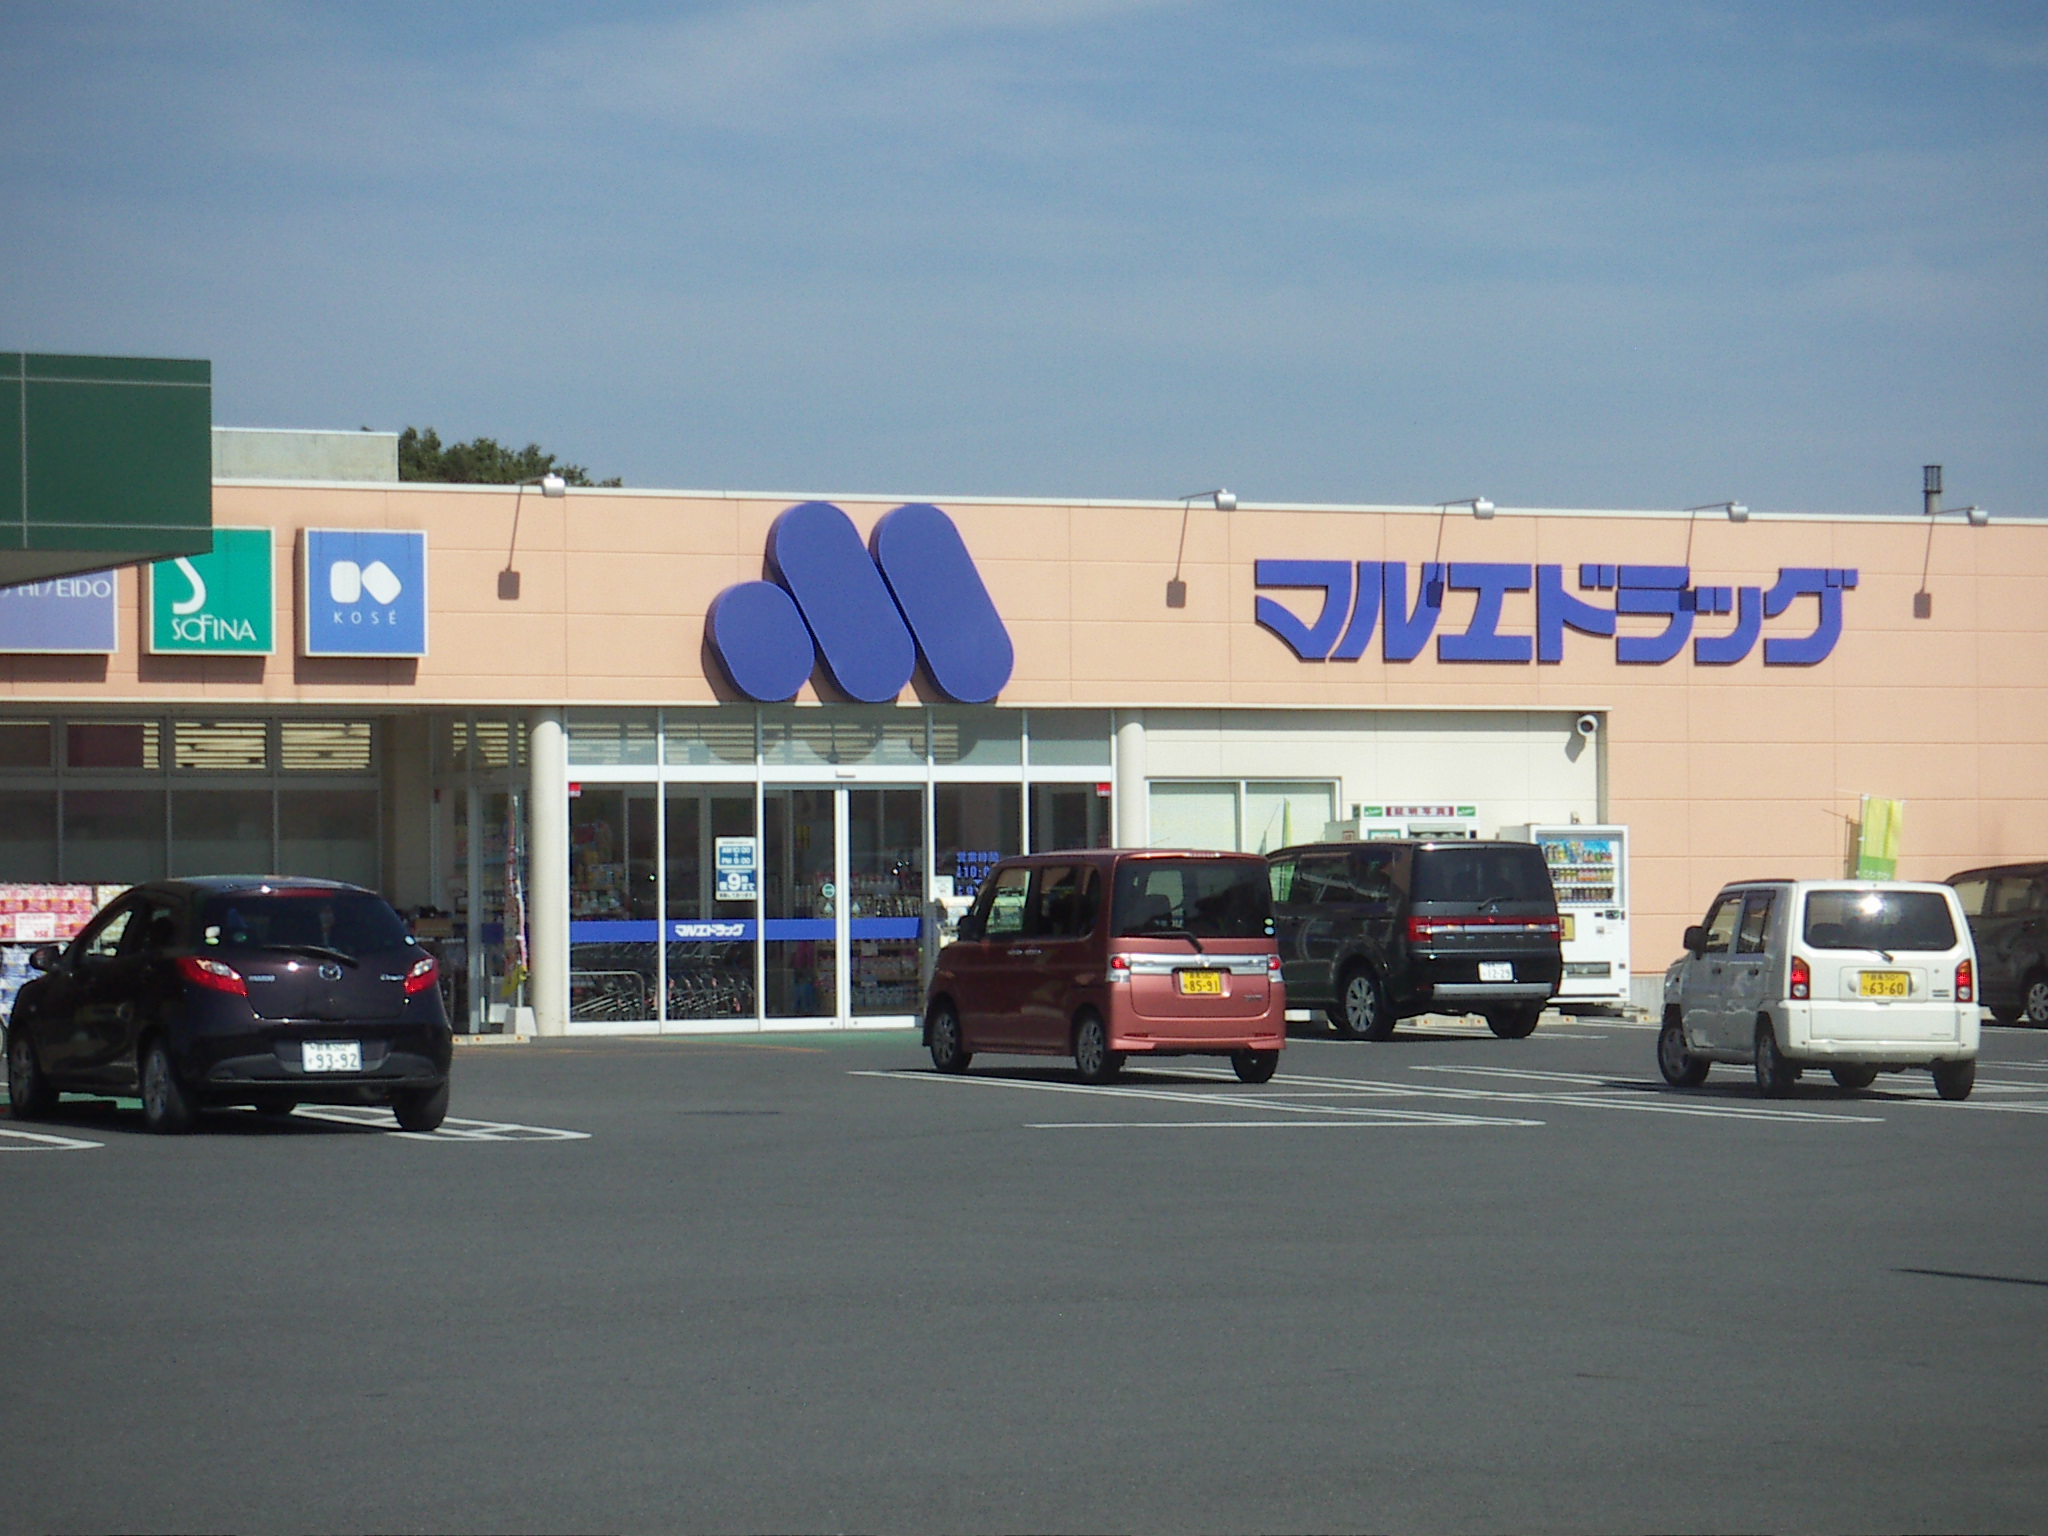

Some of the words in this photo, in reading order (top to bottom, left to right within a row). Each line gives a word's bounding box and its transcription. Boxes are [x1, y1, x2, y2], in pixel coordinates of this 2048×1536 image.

[333, 609, 398, 626] KOSÉ
[1255, 559, 1860, 664] マルエドラッグ
[1190, 980, 1218, 992] 85-91
[1870, 982, 1904, 995] 63-60
[316, 1053, 358, 1069] 93-92
